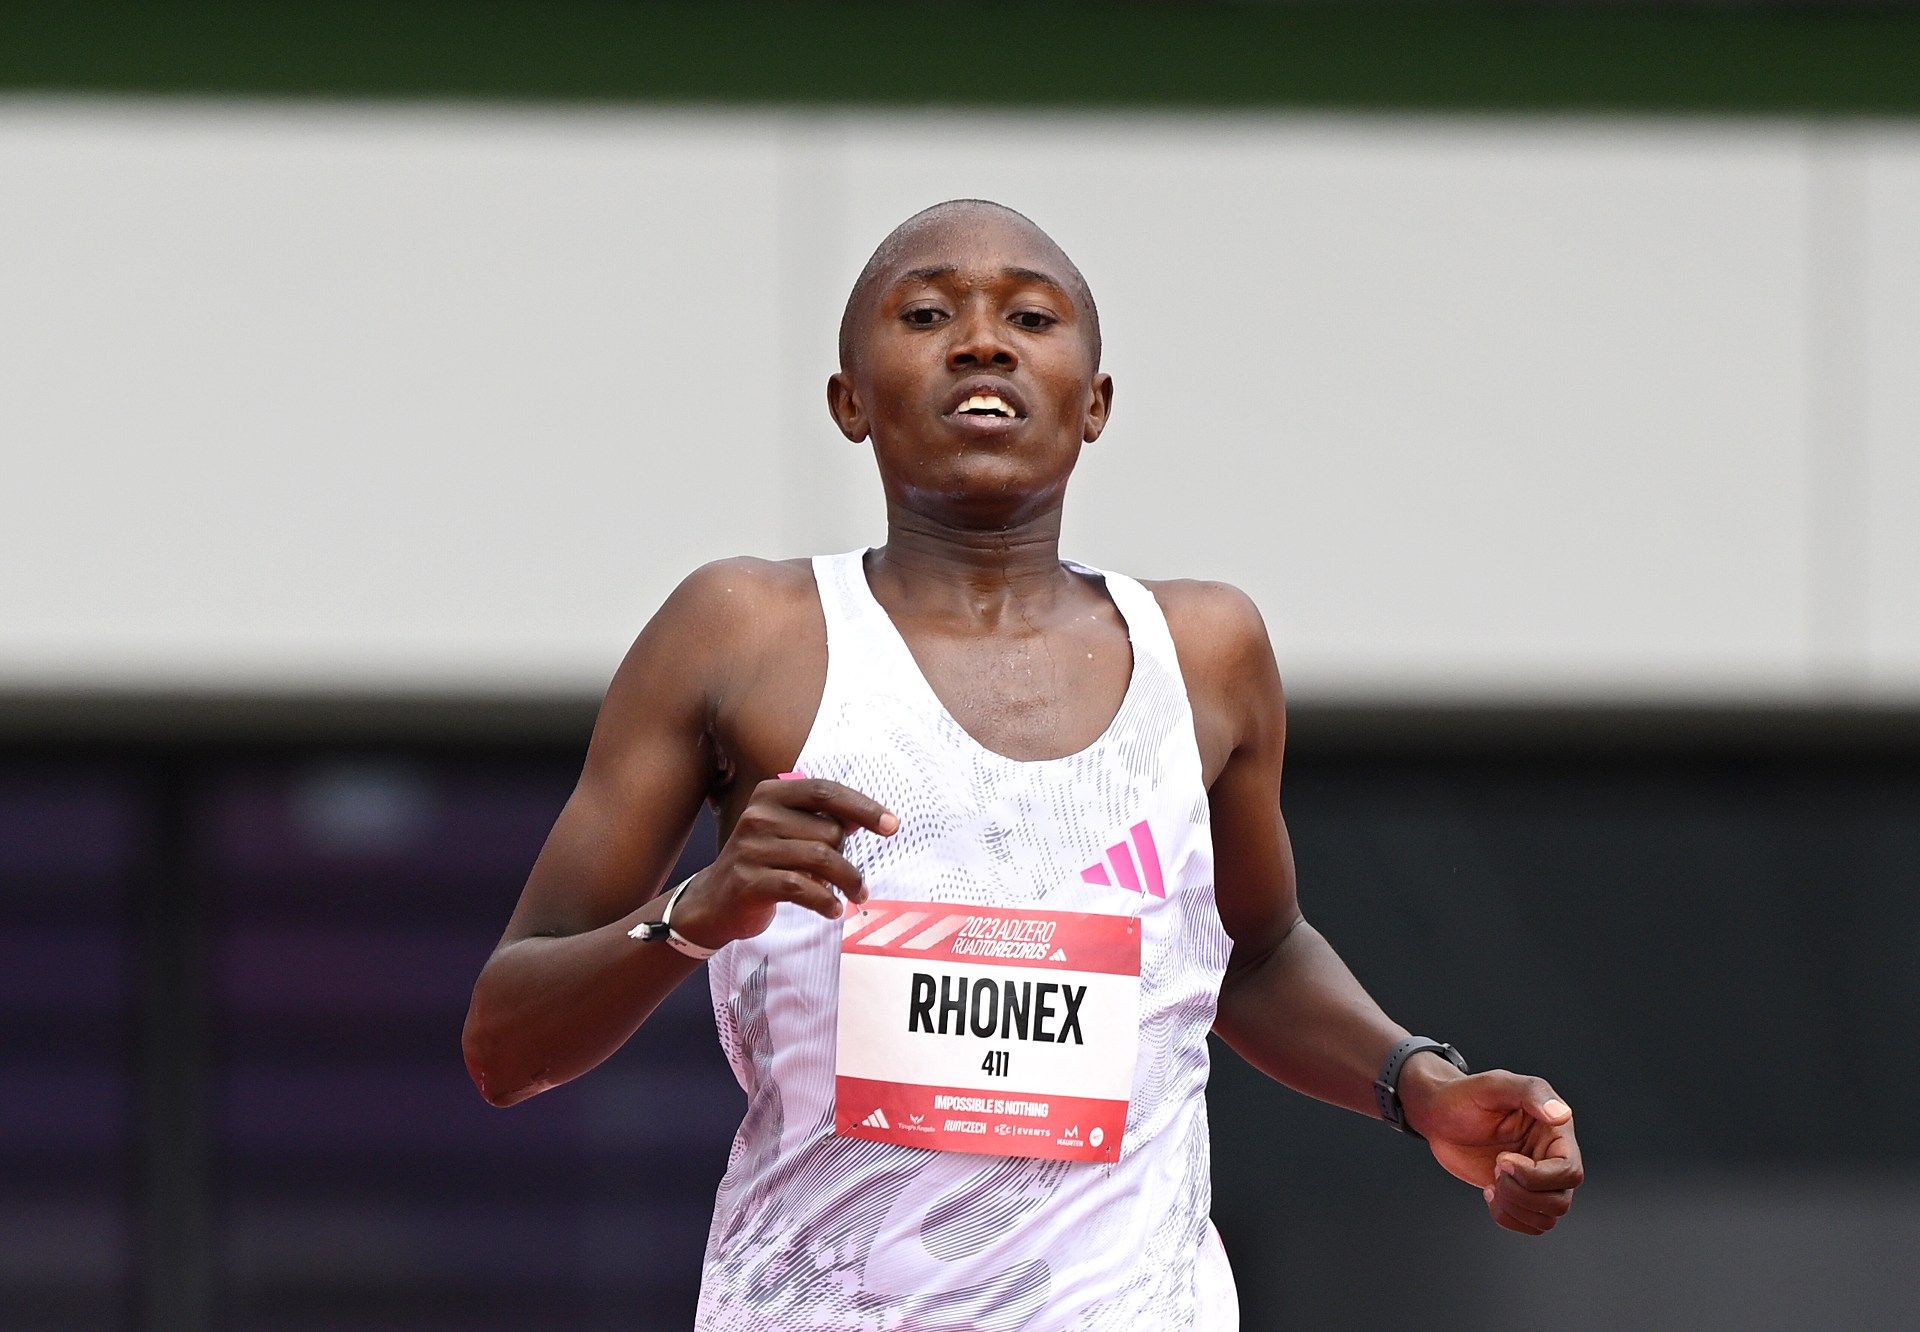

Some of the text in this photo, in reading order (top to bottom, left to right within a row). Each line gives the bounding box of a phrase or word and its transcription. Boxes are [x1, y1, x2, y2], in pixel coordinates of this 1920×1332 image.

[908, 972, 1087, 1045] RHONEX
[980, 1050, 1010, 1077] 411
[935, 1095, 1049, 1118] IMPOSSIBLE IS NOTHING
